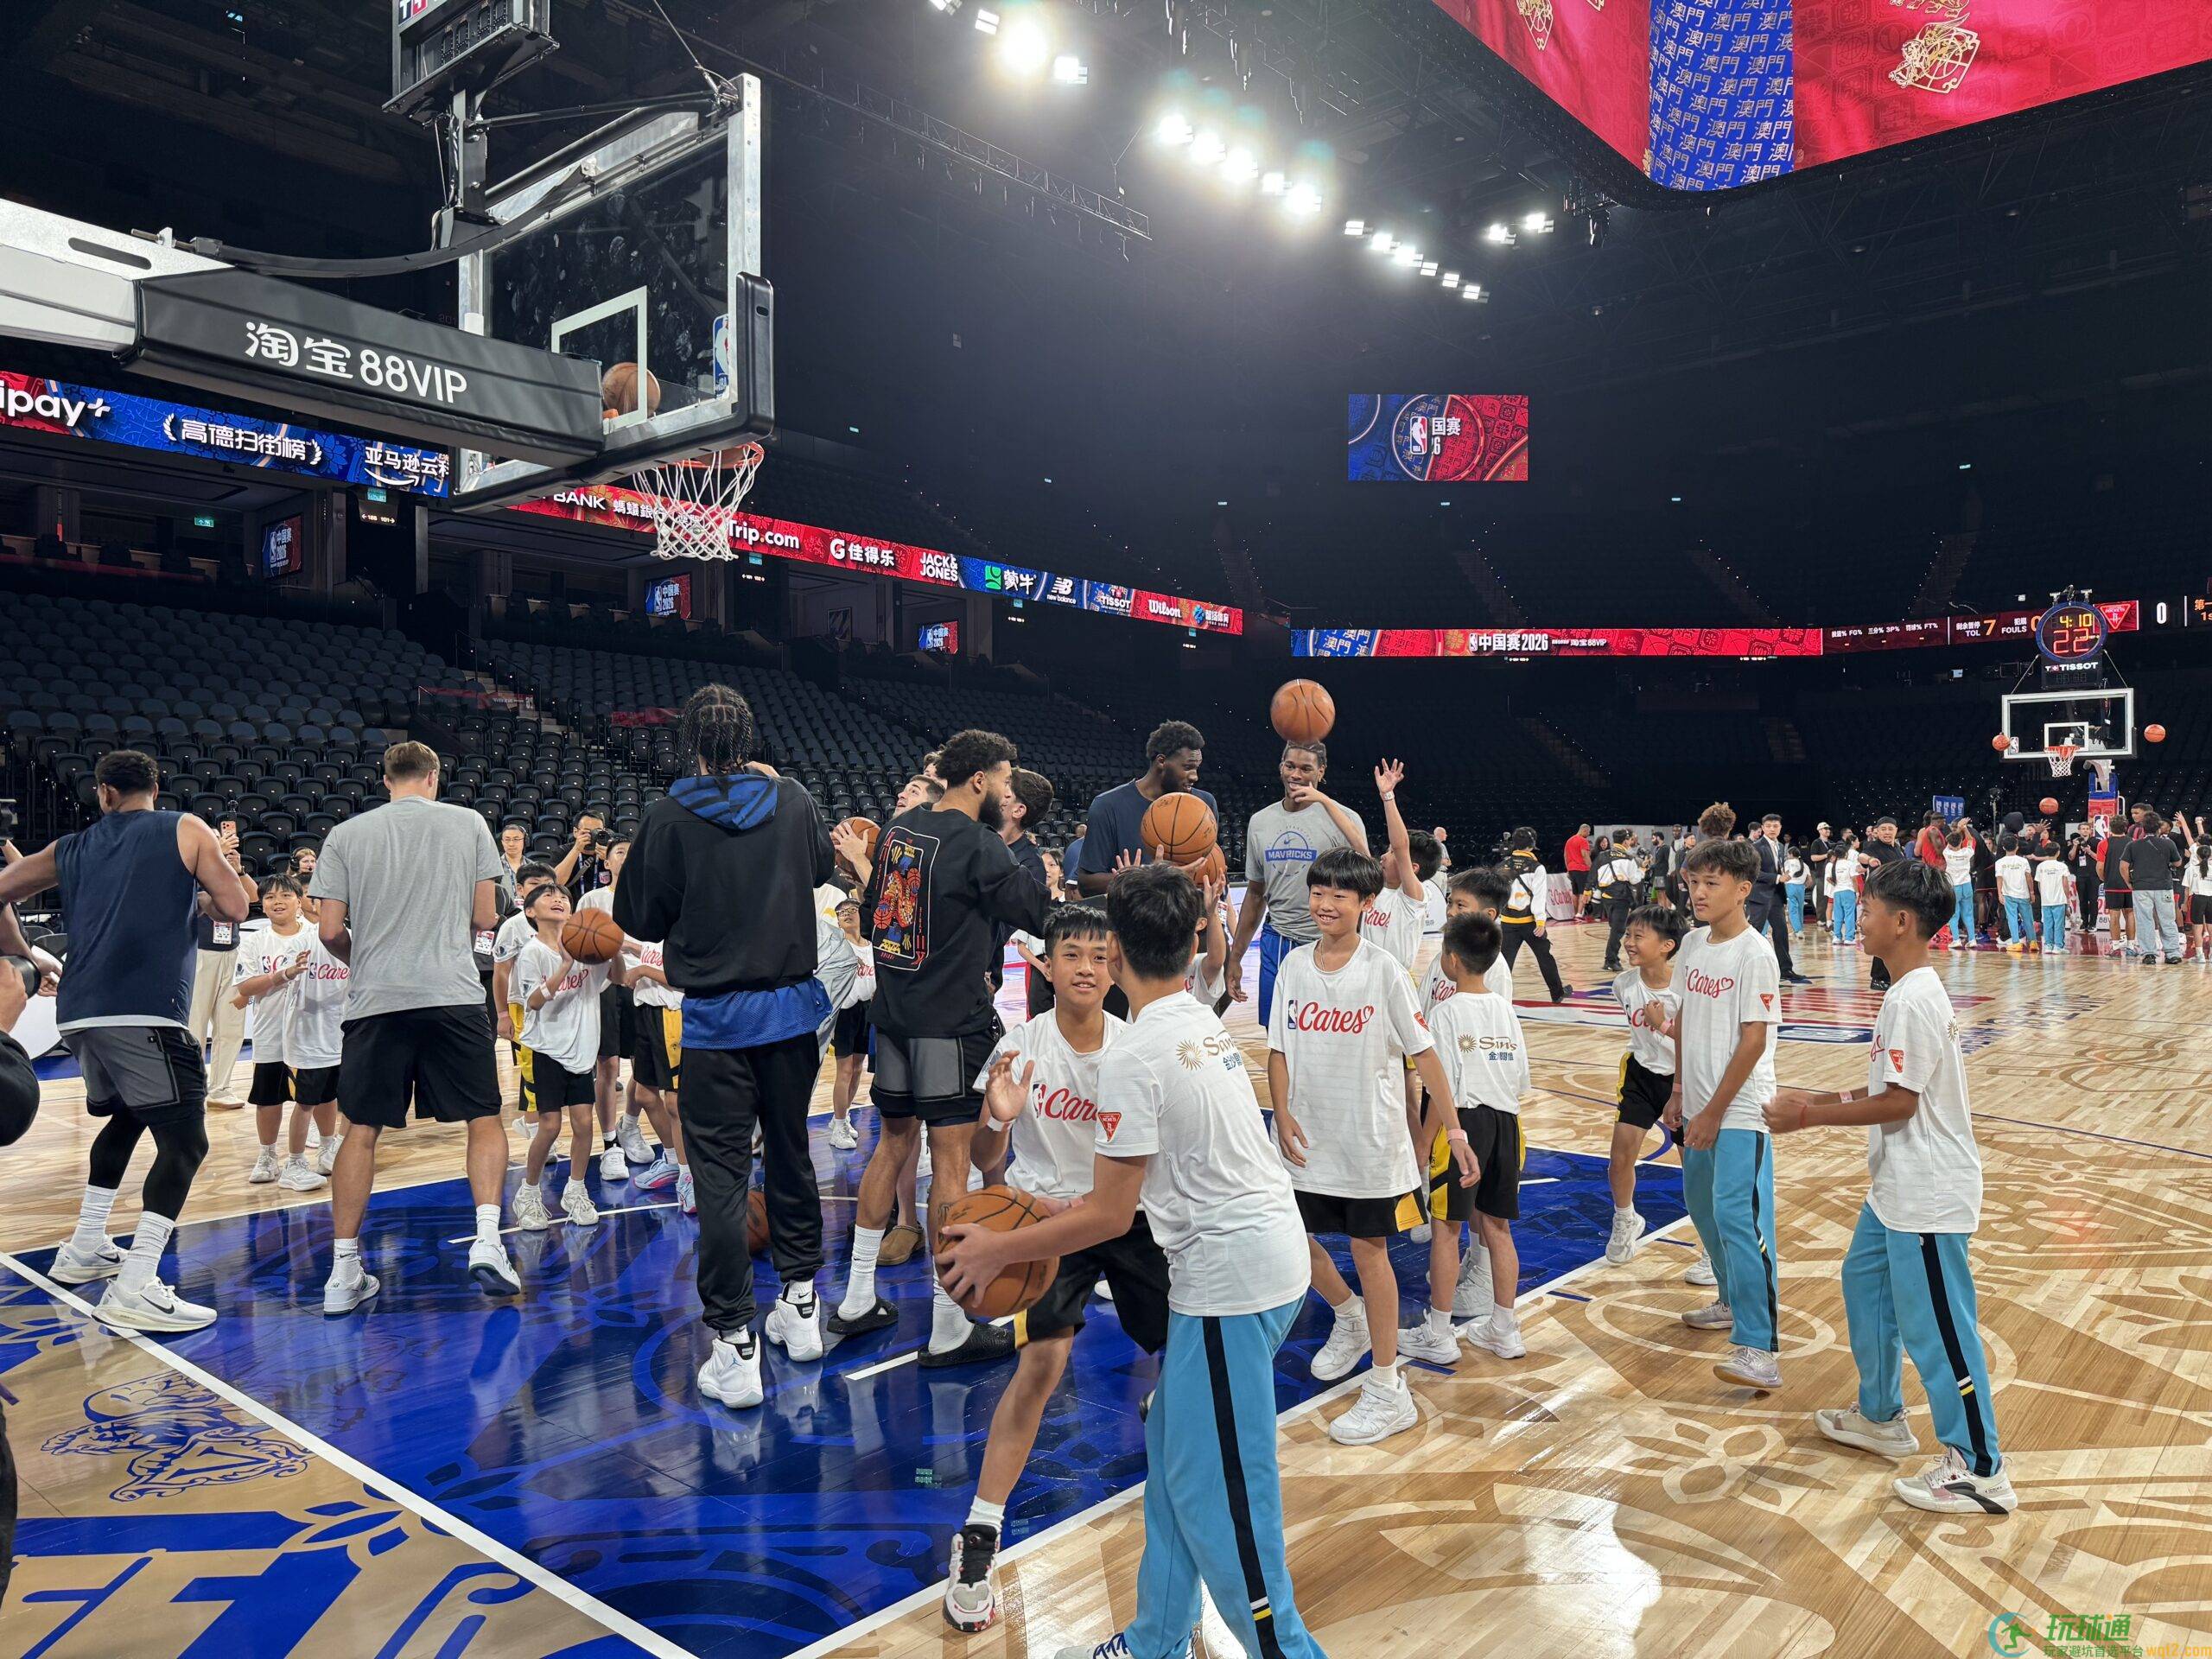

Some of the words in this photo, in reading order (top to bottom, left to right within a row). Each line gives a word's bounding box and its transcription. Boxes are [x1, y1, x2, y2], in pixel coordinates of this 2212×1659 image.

[1654, 5, 1680, 39] 澳門
[1670, 2, 1705, 27] 澳門
[1711, 12, 1751, 31] 澳門
[1684, 28, 1723, 52] 澳門
[1730, 34, 1769, 53] 澳門
[1662, 35, 1694, 67] 澳門
[1699, 53, 1739, 74] 澳門
[1745, 54, 1786, 74] 澳門
[1656, 73, 1684, 104] 澳門
[1675, 66, 1711, 93] 澳門
[1718, 77, 1758, 96] 澳門
[1688, 93, 1727, 117] 澳門
[1733, 99, 1774, 118] 澳門
[1649, 110, 1674, 143] 澳門
[1667, 104, 1700, 132] 澳門
[1706, 118, 1746, 140] 澳門
[1752, 120, 1793, 140] 澳門
[1679, 132, 1715, 158] 澳門
[1722, 142, 1762, 162] 澳門
[1768, 142, 1794, 162] 澳
[1659, 141, 1689, 172] 澳門
[1695, 159, 1734, 182] 澳門
[1740, 164, 1780, 182] 澳門
[1432, 417, 1461, 436] 国赛
[181, 419, 306, 461] 高德扫街榜
[728, 519, 799, 550] Trip.com
[849, 543, 894, 567] 佳得乐
[919, 552, 958, 568] JACK&
[919, 566, 958, 582] JONES
[1003, 569, 1034, 594] 蒙牛
[1057, 595, 1077, 604] balance
[1102, 596, 1131, 609] TISSOT
[1149, 599, 1181, 618] Wilson
[2059, 613, 2092, 628] 4:10
[2157, 602, 2167, 624] 0
[1984, 619, 1996, 635] 7
[1323, 635, 1351, 654] 澳門
[2053, 627, 2089, 654] 22
[2060, 662, 2099, 671] TISSOT
[317, 963, 348, 980] Care
[556, 973, 584, 993] ares
[1435, 980, 1457, 1001] Car
[1688, 969, 1720, 998] Cares
[1299, 1002, 1365, 1033] Cares
[1045, 1088, 1096, 1122] Car
